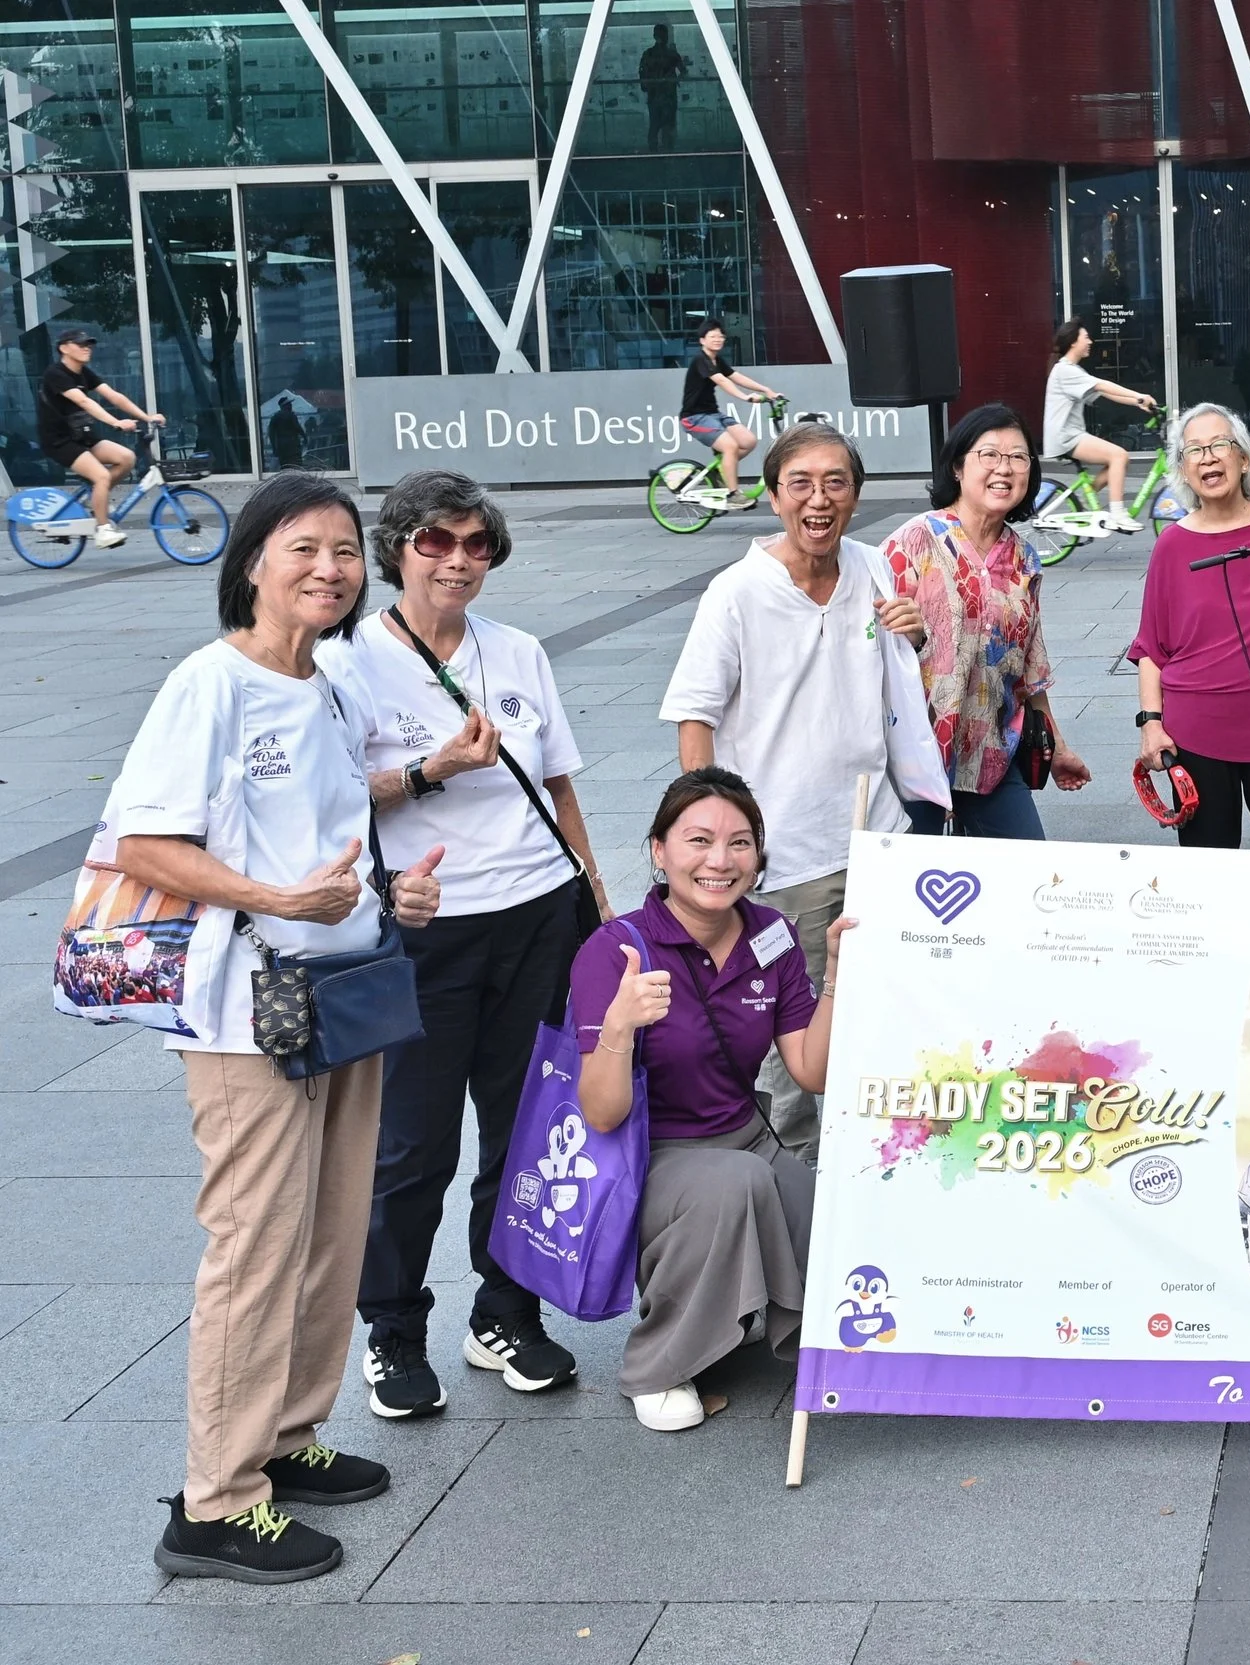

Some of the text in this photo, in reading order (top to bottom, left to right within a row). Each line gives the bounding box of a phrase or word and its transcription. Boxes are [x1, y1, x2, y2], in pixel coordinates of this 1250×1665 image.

[1108, 317, 1126, 325] Design
[394, 410, 468, 450] Red
[485, 408, 558, 448] Dot
[573, 405, 693, 454] Desig
[399, 724, 428, 735] Walk
[252, 750, 287, 763] Walk
[251, 763, 292, 777] Health
[901, 930, 986, 946] Blossom Seeds
[1054, 932, 1087, 941] President's
[930, 947, 953, 959] 福善
[1026, 942, 1114, 953] Certificate of Commendation
[857, 1077, 1225, 1132] READY SET Gold!
[1143, 1135, 1160, 1144] Age
[1162, 1133, 1180, 1141] Well
[976, 1130, 1096, 1174] 2026
[1134, 1169, 1177, 1191] CHOPE
[506, 1215, 518, 1227] To
[921, 1276, 1024, 1289] Sector Administrator
[1058, 1280, 1113, 1290] Member of
[1160, 1282, 1217, 1294] Operator of
[1082, 1325, 1110, 1336] NCSS
[1151, 1319, 1211, 1332] SG Cares
[934, 1329, 965, 1338] MINISTRY
[1174, 1332, 1205, 1340] Volunteer
[1208, 1375, 1244, 1405] To
